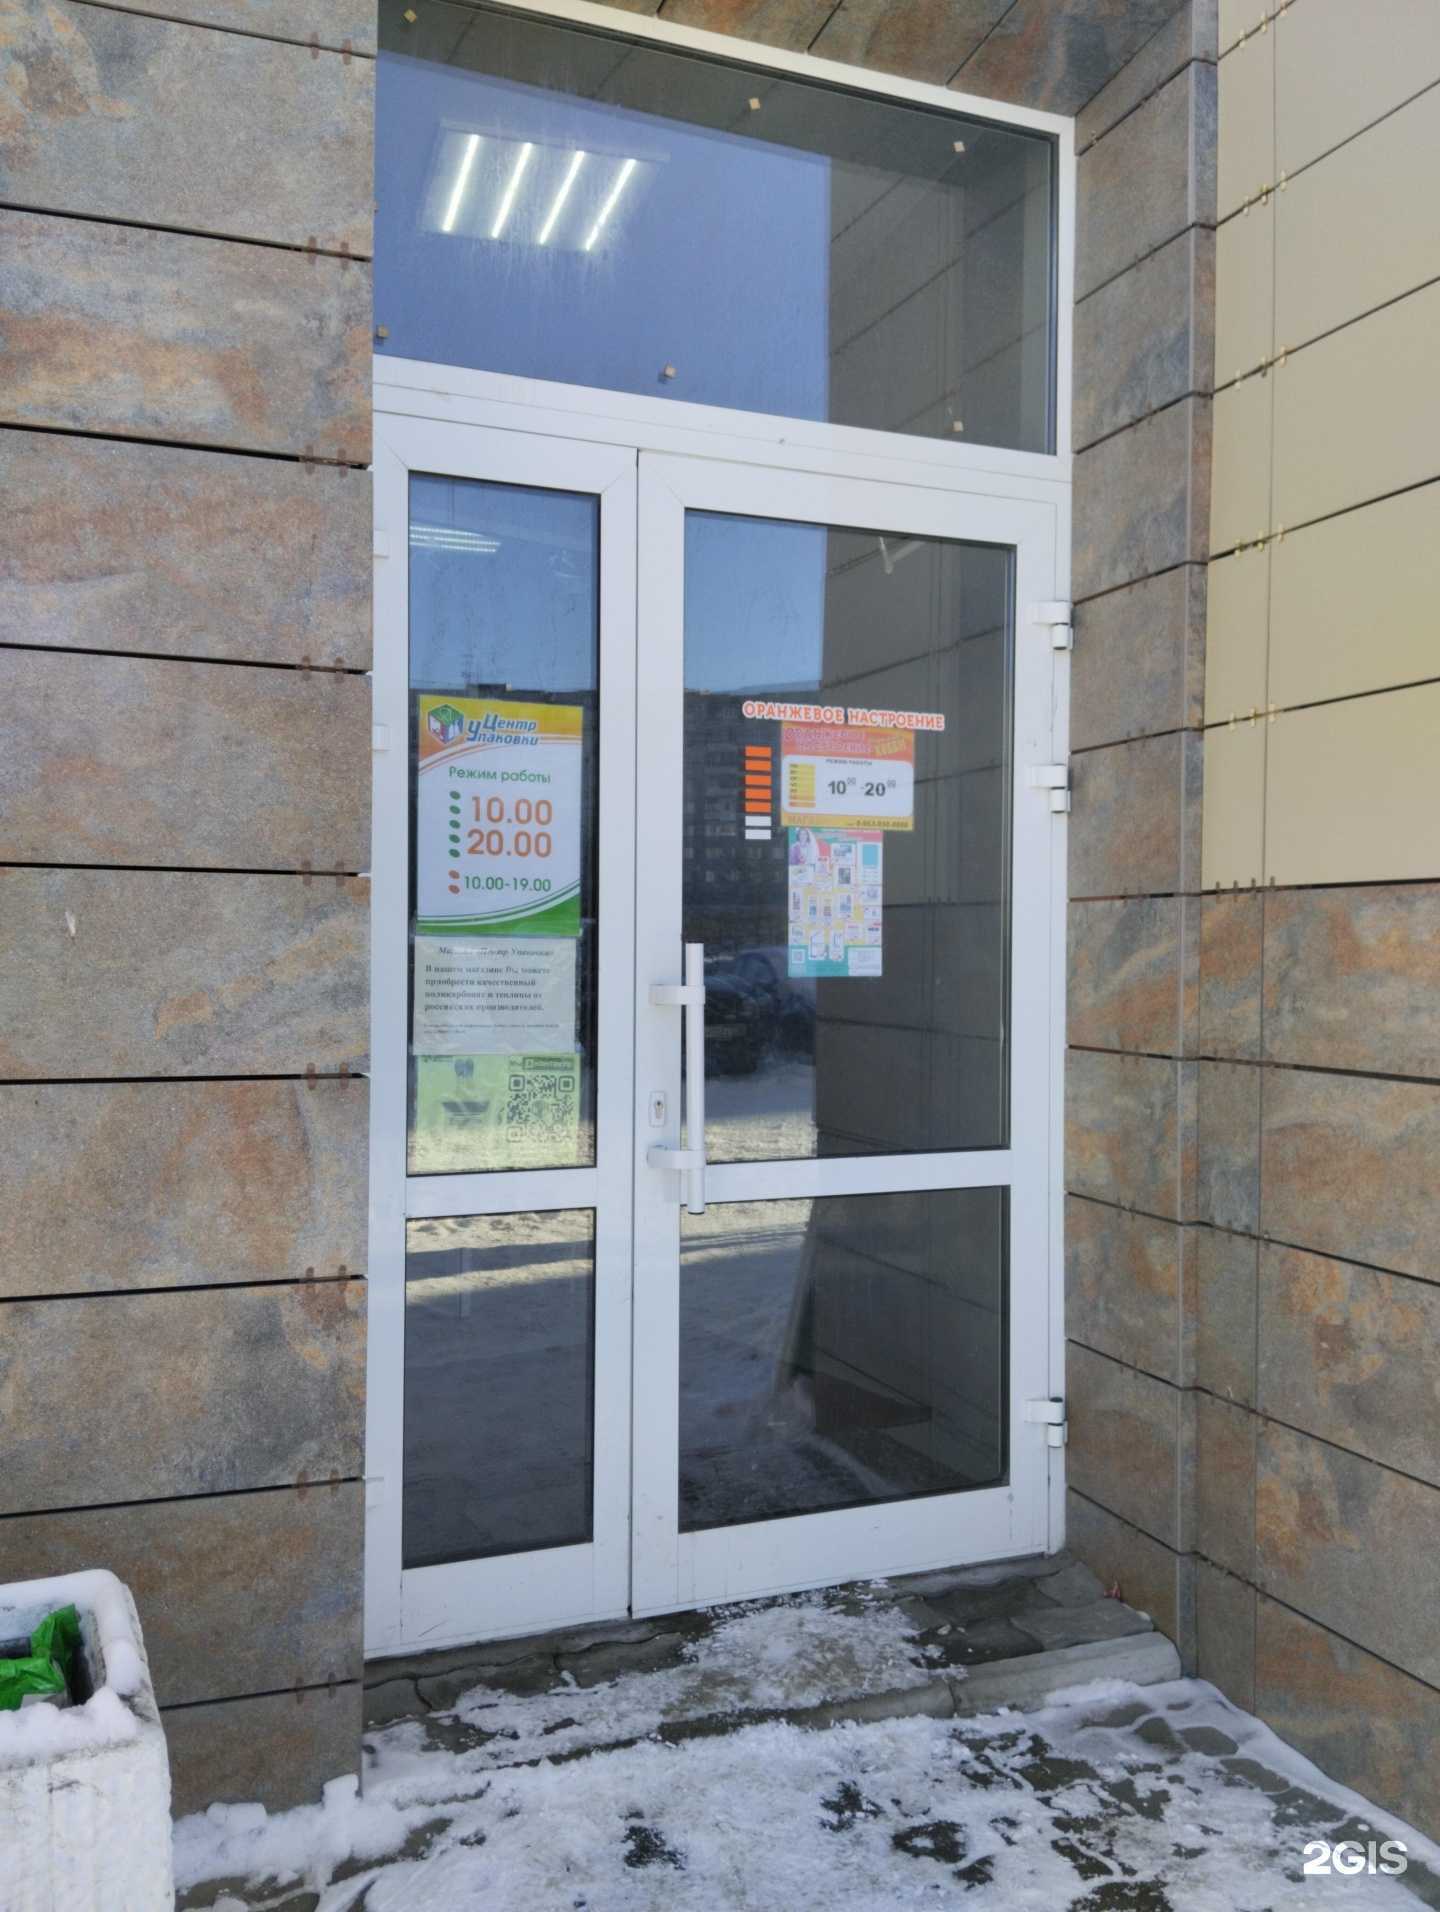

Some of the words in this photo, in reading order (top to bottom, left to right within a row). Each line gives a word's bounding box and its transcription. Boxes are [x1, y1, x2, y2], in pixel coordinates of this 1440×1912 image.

[482, 713, 537, 733] Центр
[743, 702, 844, 724] ОРАНЖЕВОЕ
[847, 708, 944, 730] НАСТРОЕНИЕ
[450, 766, 497, 781] Режим
[501, 769, 551, 784] работы
[471, 796, 553, 826] 10.00
[467, 828, 553, 859] 20.00
[464, 875, 552, 893] 10.00-19.00
